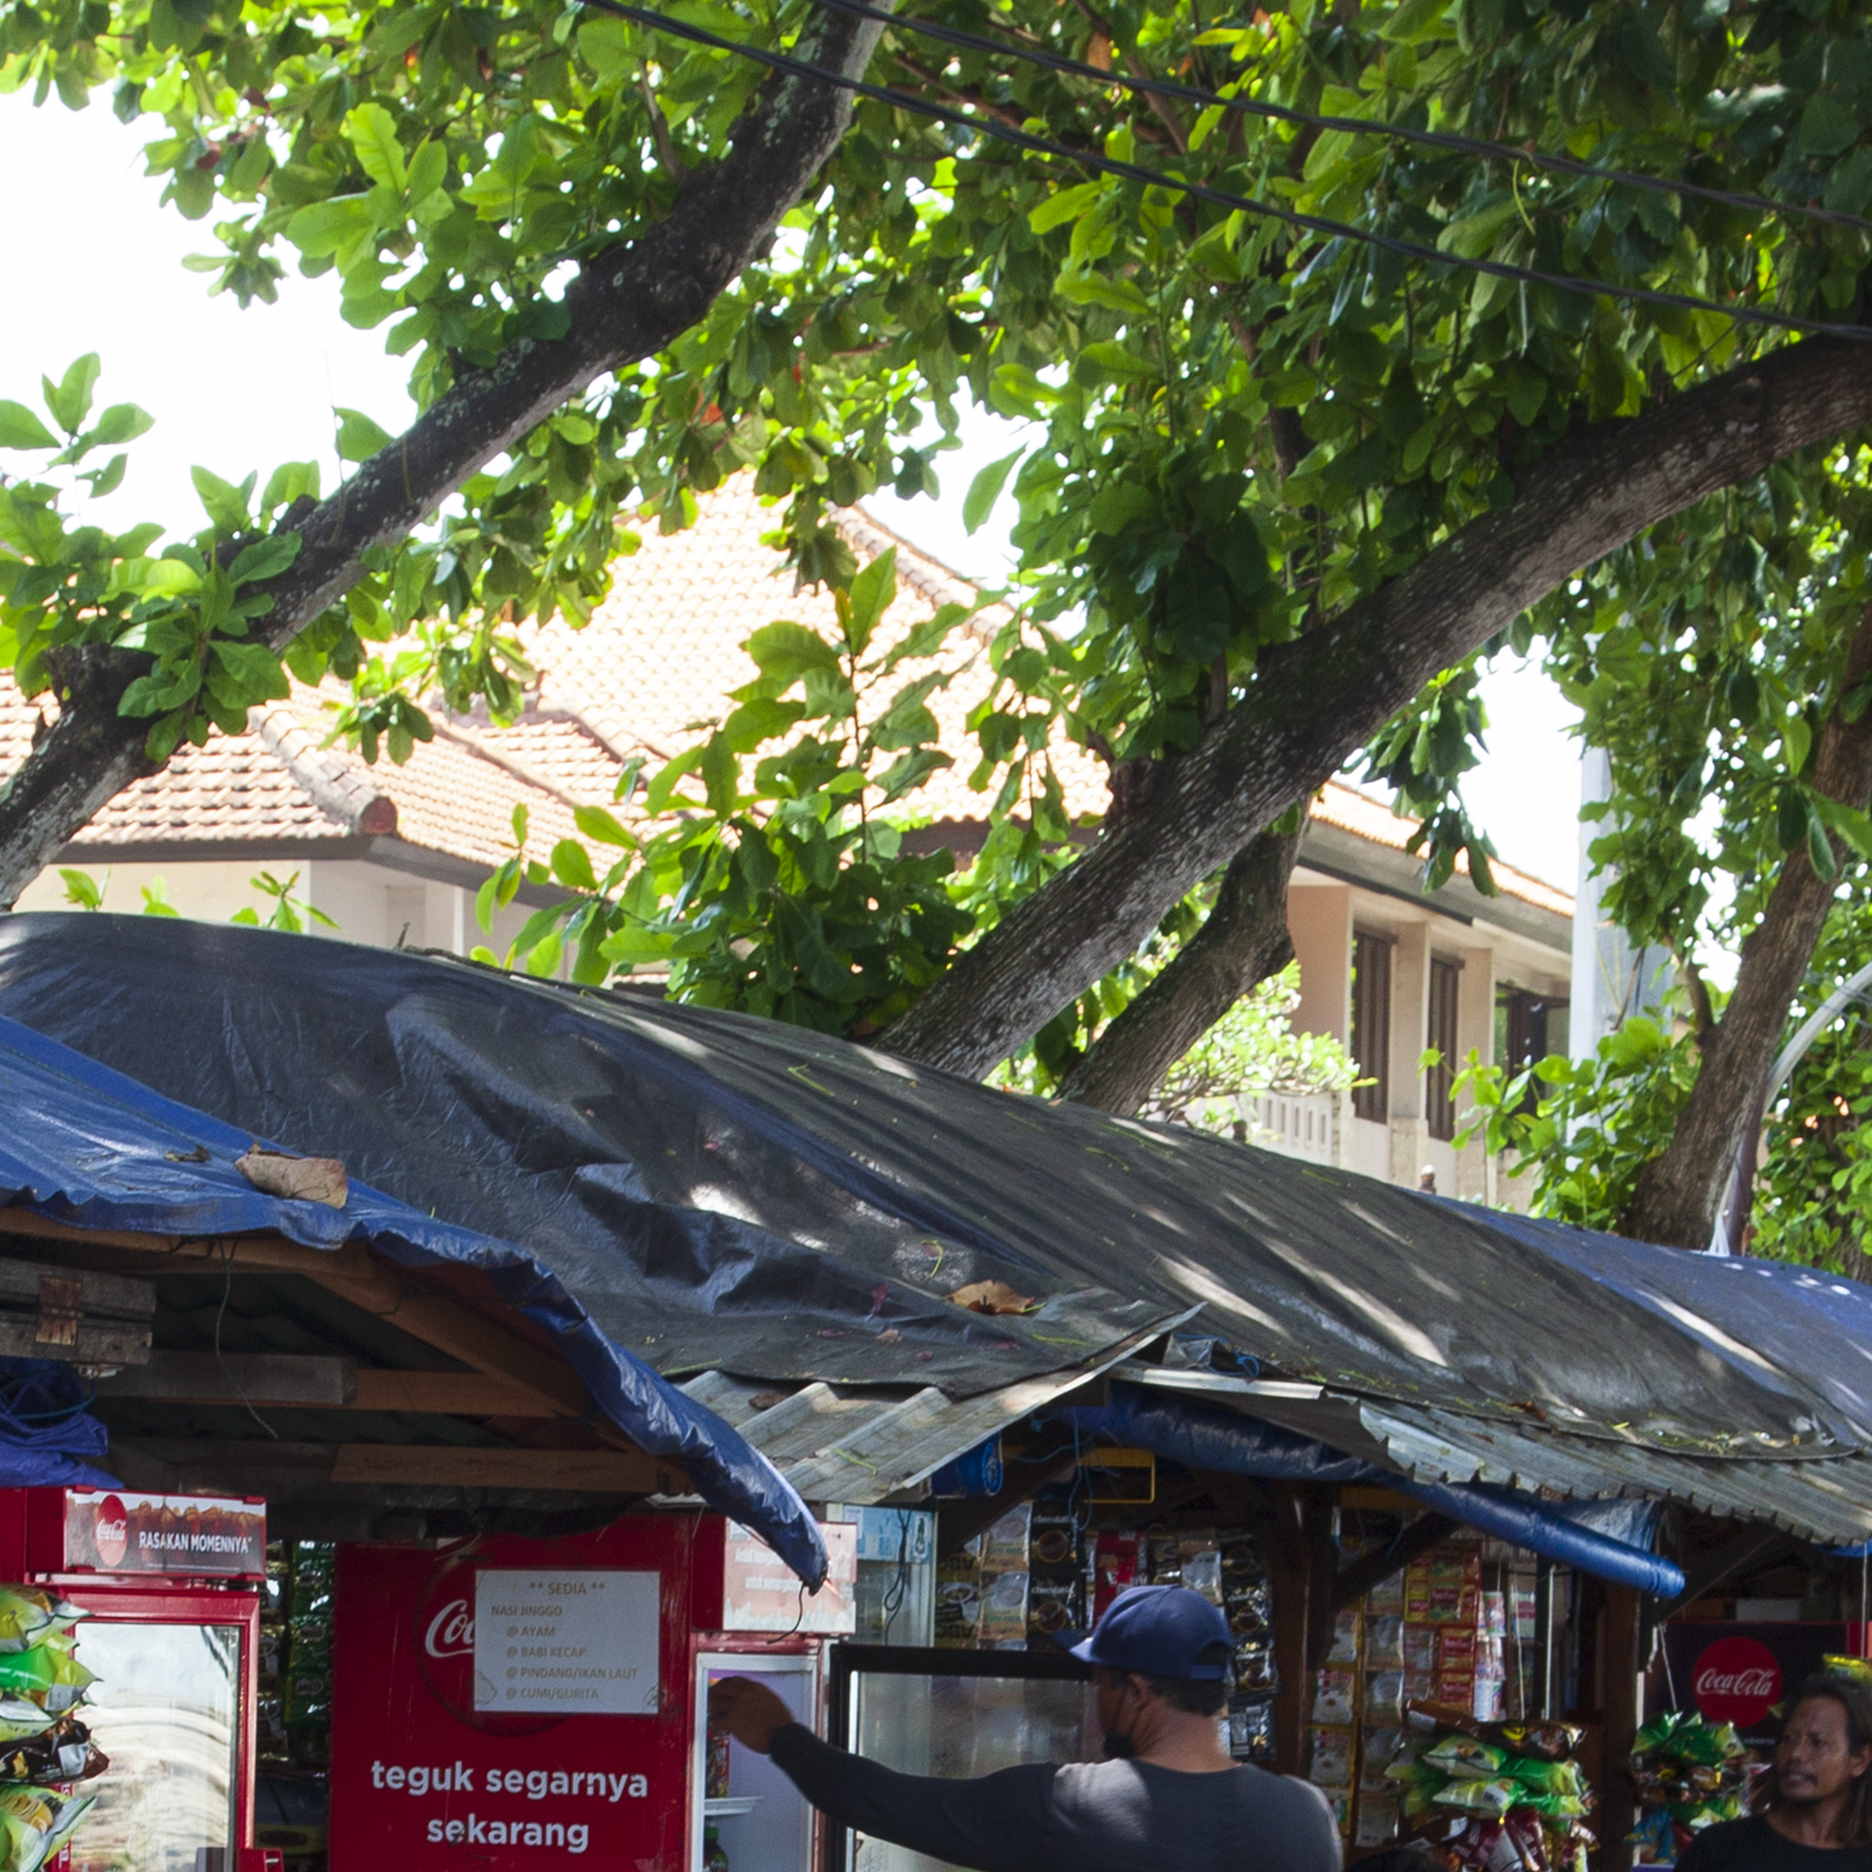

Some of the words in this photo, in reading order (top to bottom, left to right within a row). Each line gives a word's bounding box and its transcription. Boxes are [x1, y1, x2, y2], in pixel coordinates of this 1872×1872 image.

[140, 1531, 189, 1550] RASAKAN
[548, 1582, 586, 1595] SEDIA
[491, 1605, 517, 1616] NASI
[520, 1605, 563, 1617] JINGGO
[521, 1626, 556, 1637] AYAM
[521, 1646, 547, 1658] BABI
[549, 1646, 586, 1658] KECAP
[609, 1667, 638, 1680] LAUT
[1696, 1667, 1778, 1696] Coca-Cola
[371, 1760, 474, 1797] teguk
[485, 1768, 648, 1803] segarnya
[426, 1812, 589, 1853] sekarang
